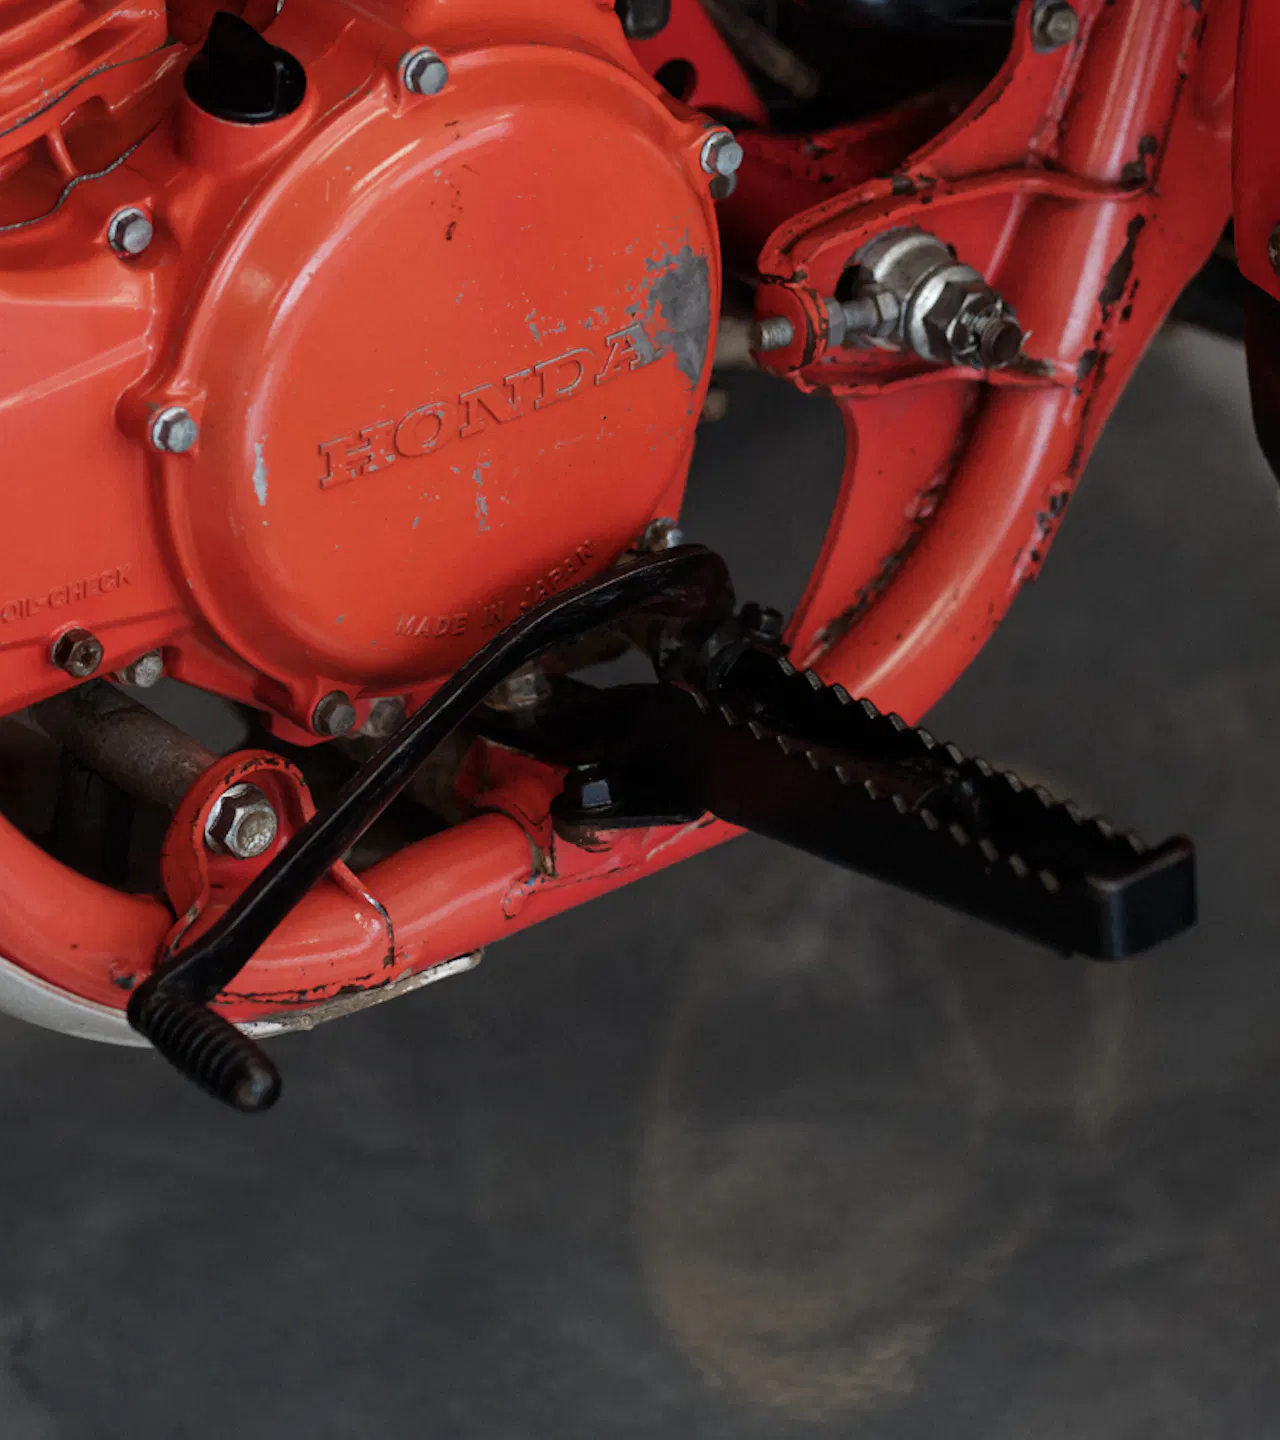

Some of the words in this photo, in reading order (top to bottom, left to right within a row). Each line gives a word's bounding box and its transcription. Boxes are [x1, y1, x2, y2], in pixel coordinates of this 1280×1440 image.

[318, 321, 665, 490] HONDA
[396, 612, 468, 637] MADE
[479, 601, 505, 629] IN
[520, 538, 594, 613] JAPAN
